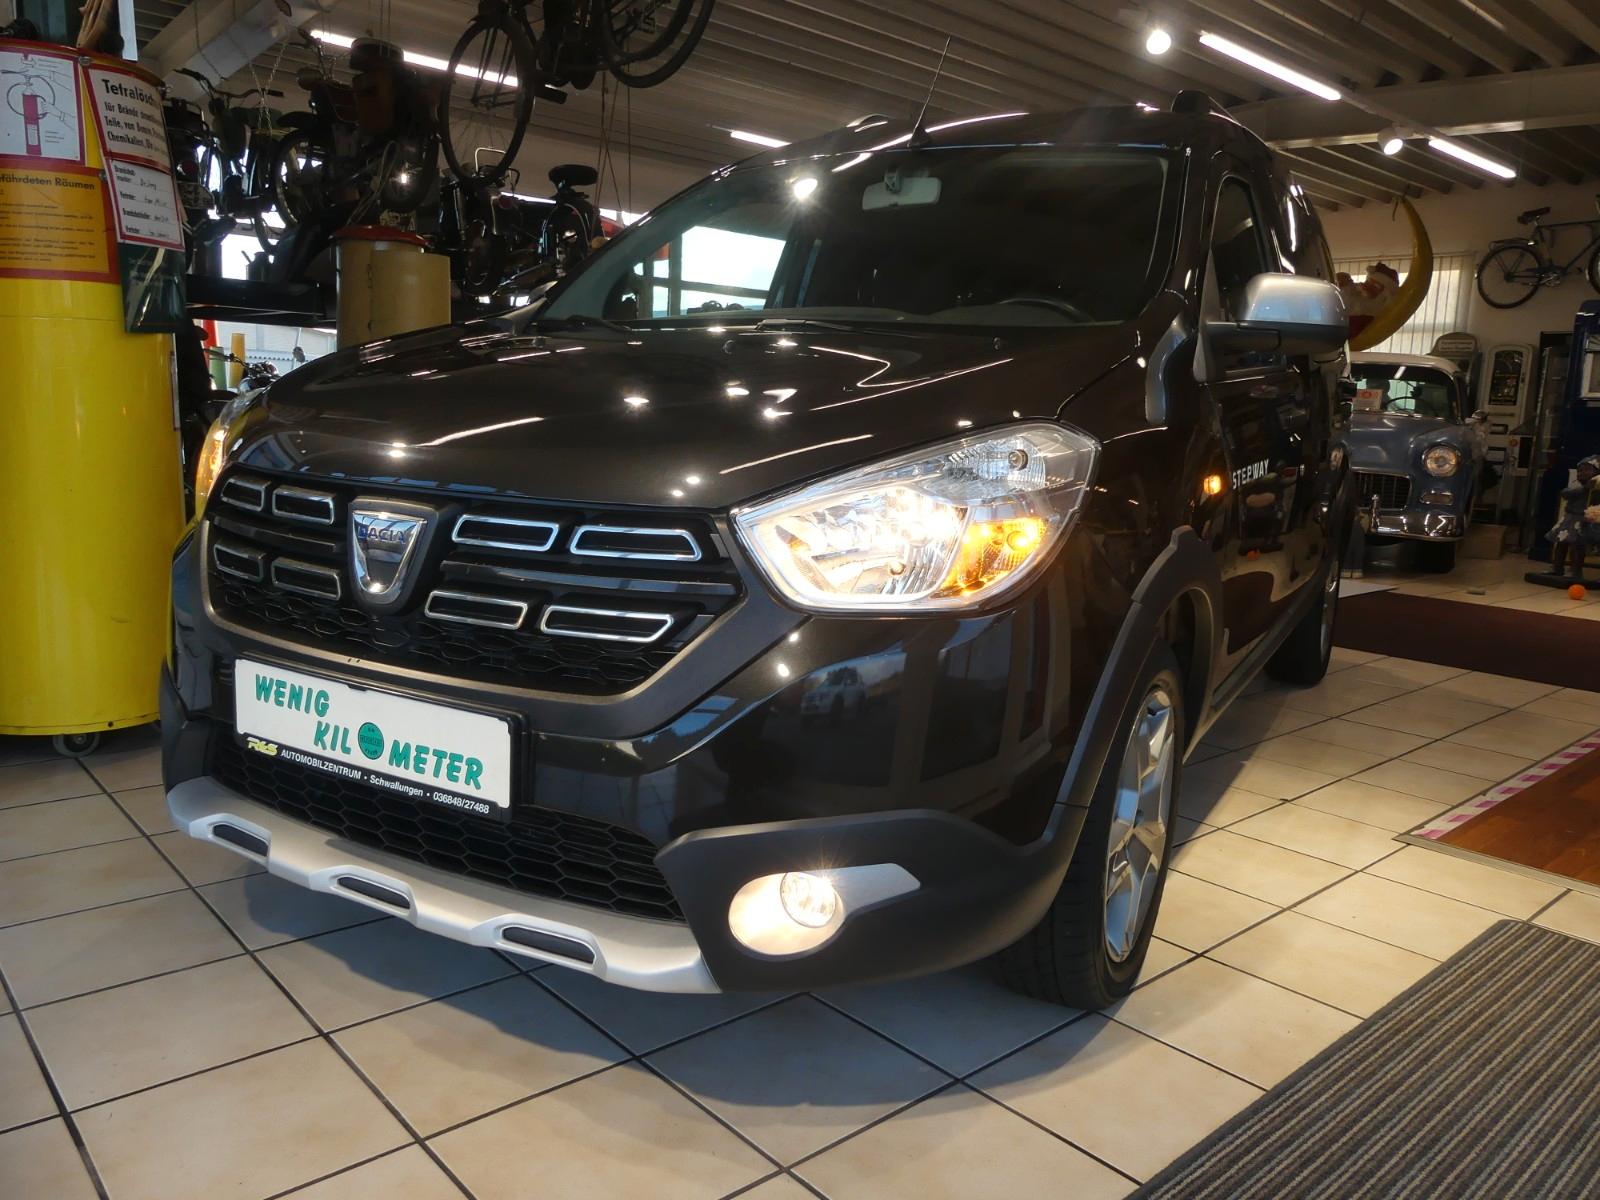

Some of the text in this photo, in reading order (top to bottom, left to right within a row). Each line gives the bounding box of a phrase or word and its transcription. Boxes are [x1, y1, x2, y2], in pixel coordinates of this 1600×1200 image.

[101, 78, 156, 106] Tetralösc
[0, 172, 96, 190] fährdeten Räumen
[1232, 459, 1269, 490] STEPWAY
[358, 525, 406, 545] DACIA
[255, 673, 330, 718] WENIG
[280, 749, 361, 780] AUTOMOBILZENTRUM
[370, 775, 424, 797] Schwallungen
[433, 791, 490, 814] 036848/27488
